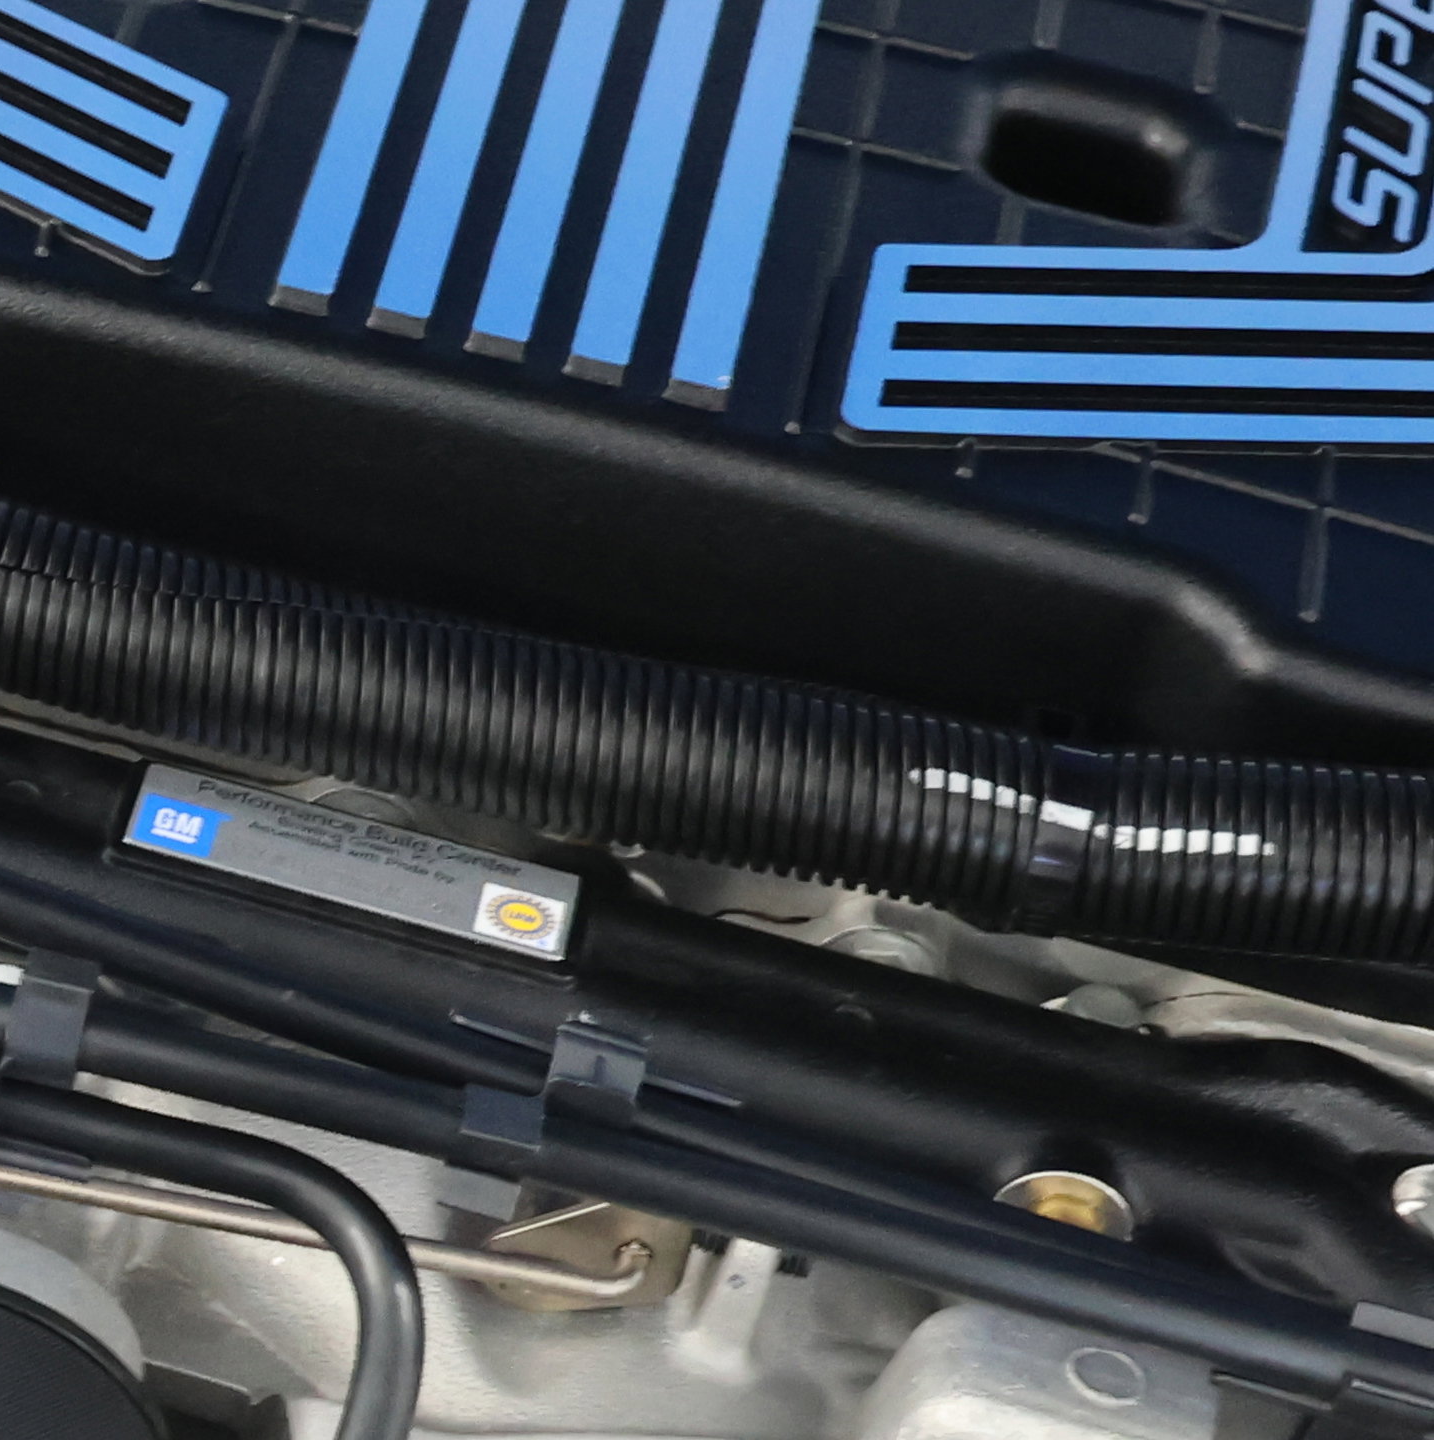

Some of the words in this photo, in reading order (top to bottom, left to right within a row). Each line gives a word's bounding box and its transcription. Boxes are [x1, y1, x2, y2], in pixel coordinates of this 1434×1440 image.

[152, 807, 205, 839] GM
[197, 779, 357, 834] Performance
[436, 844, 523, 876] Center
